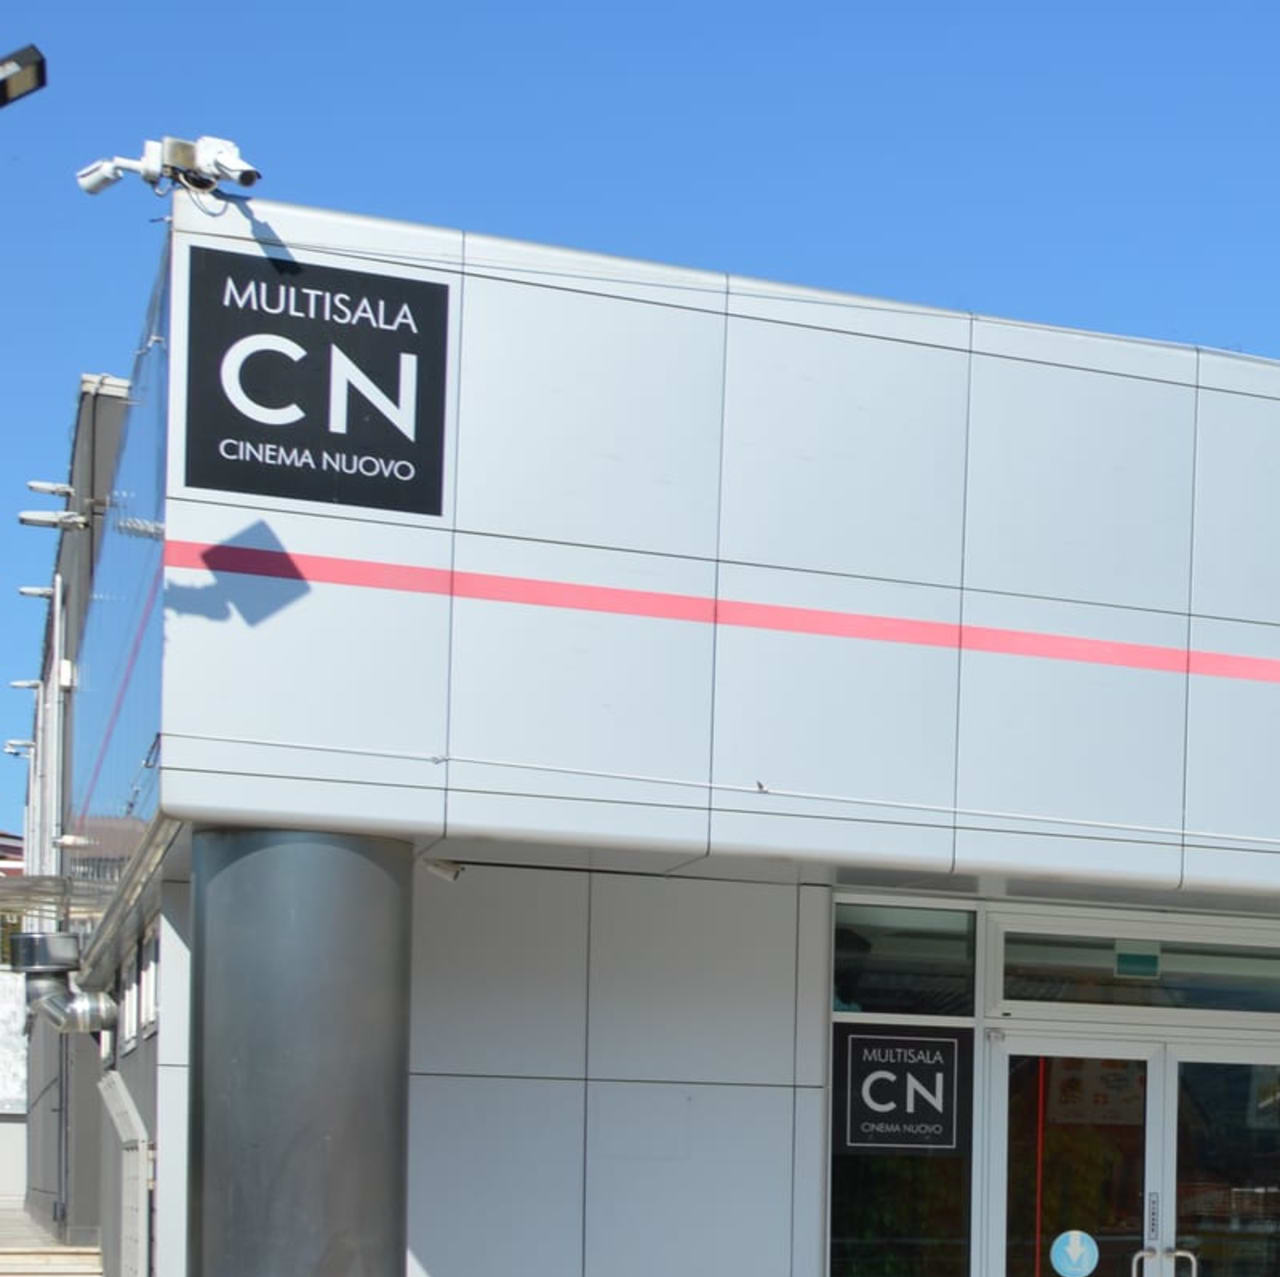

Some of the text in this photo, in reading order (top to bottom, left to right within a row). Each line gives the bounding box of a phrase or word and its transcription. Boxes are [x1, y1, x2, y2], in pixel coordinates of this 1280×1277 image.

[222, 275, 419, 334] MULTISALA
[220, 333, 418, 443] CN
[218, 437, 417, 482] CINEMA NUOVO
[862, 1048, 944, 1064] MULTISALA
[861, 1070, 943, 1113] CN
[861, 1121, 943, 1134] CINEMA NUOVO
